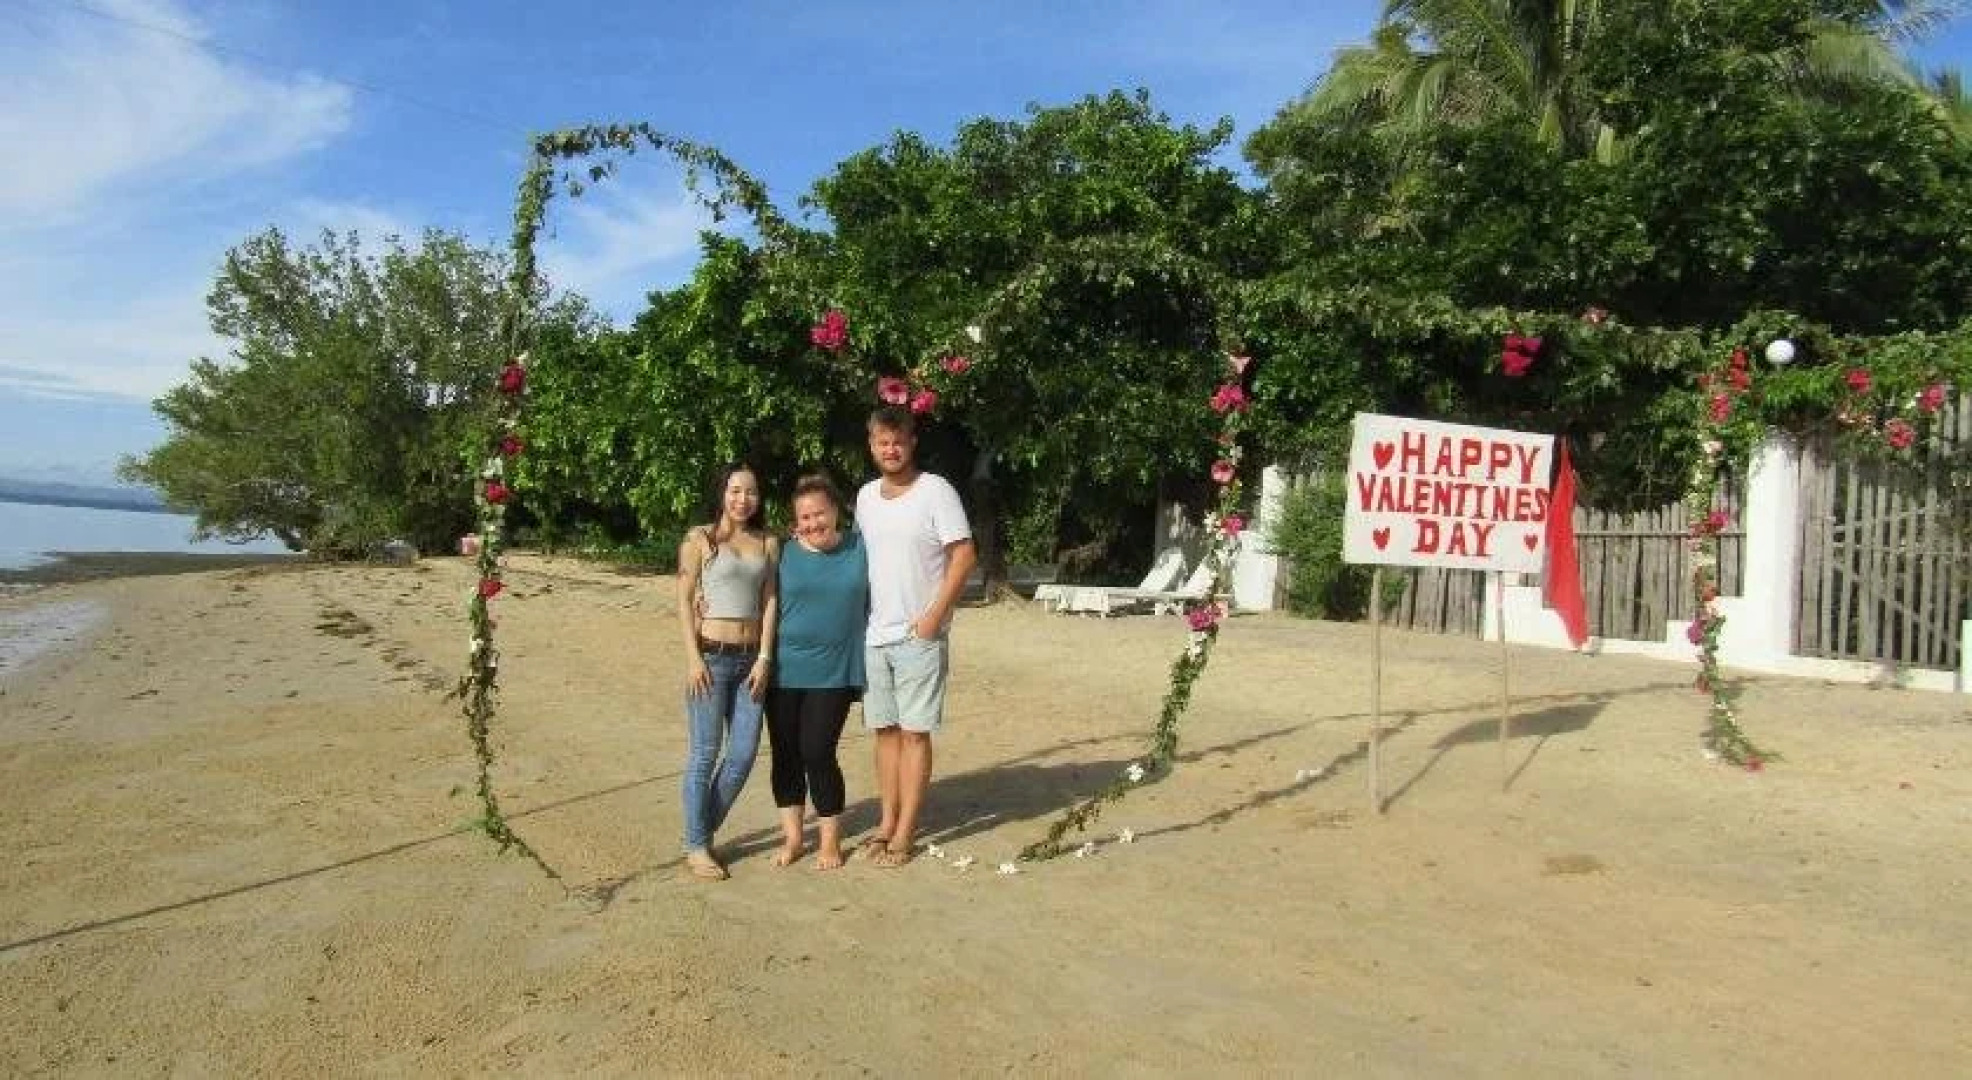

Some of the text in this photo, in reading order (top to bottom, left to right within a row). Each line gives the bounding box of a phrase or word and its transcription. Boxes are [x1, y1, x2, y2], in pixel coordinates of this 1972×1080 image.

[1399, 431, 1541, 484] HAPPY
[1356, 471, 1549, 522] VALENTINES
[1411, 518, 1496, 557] DAY
